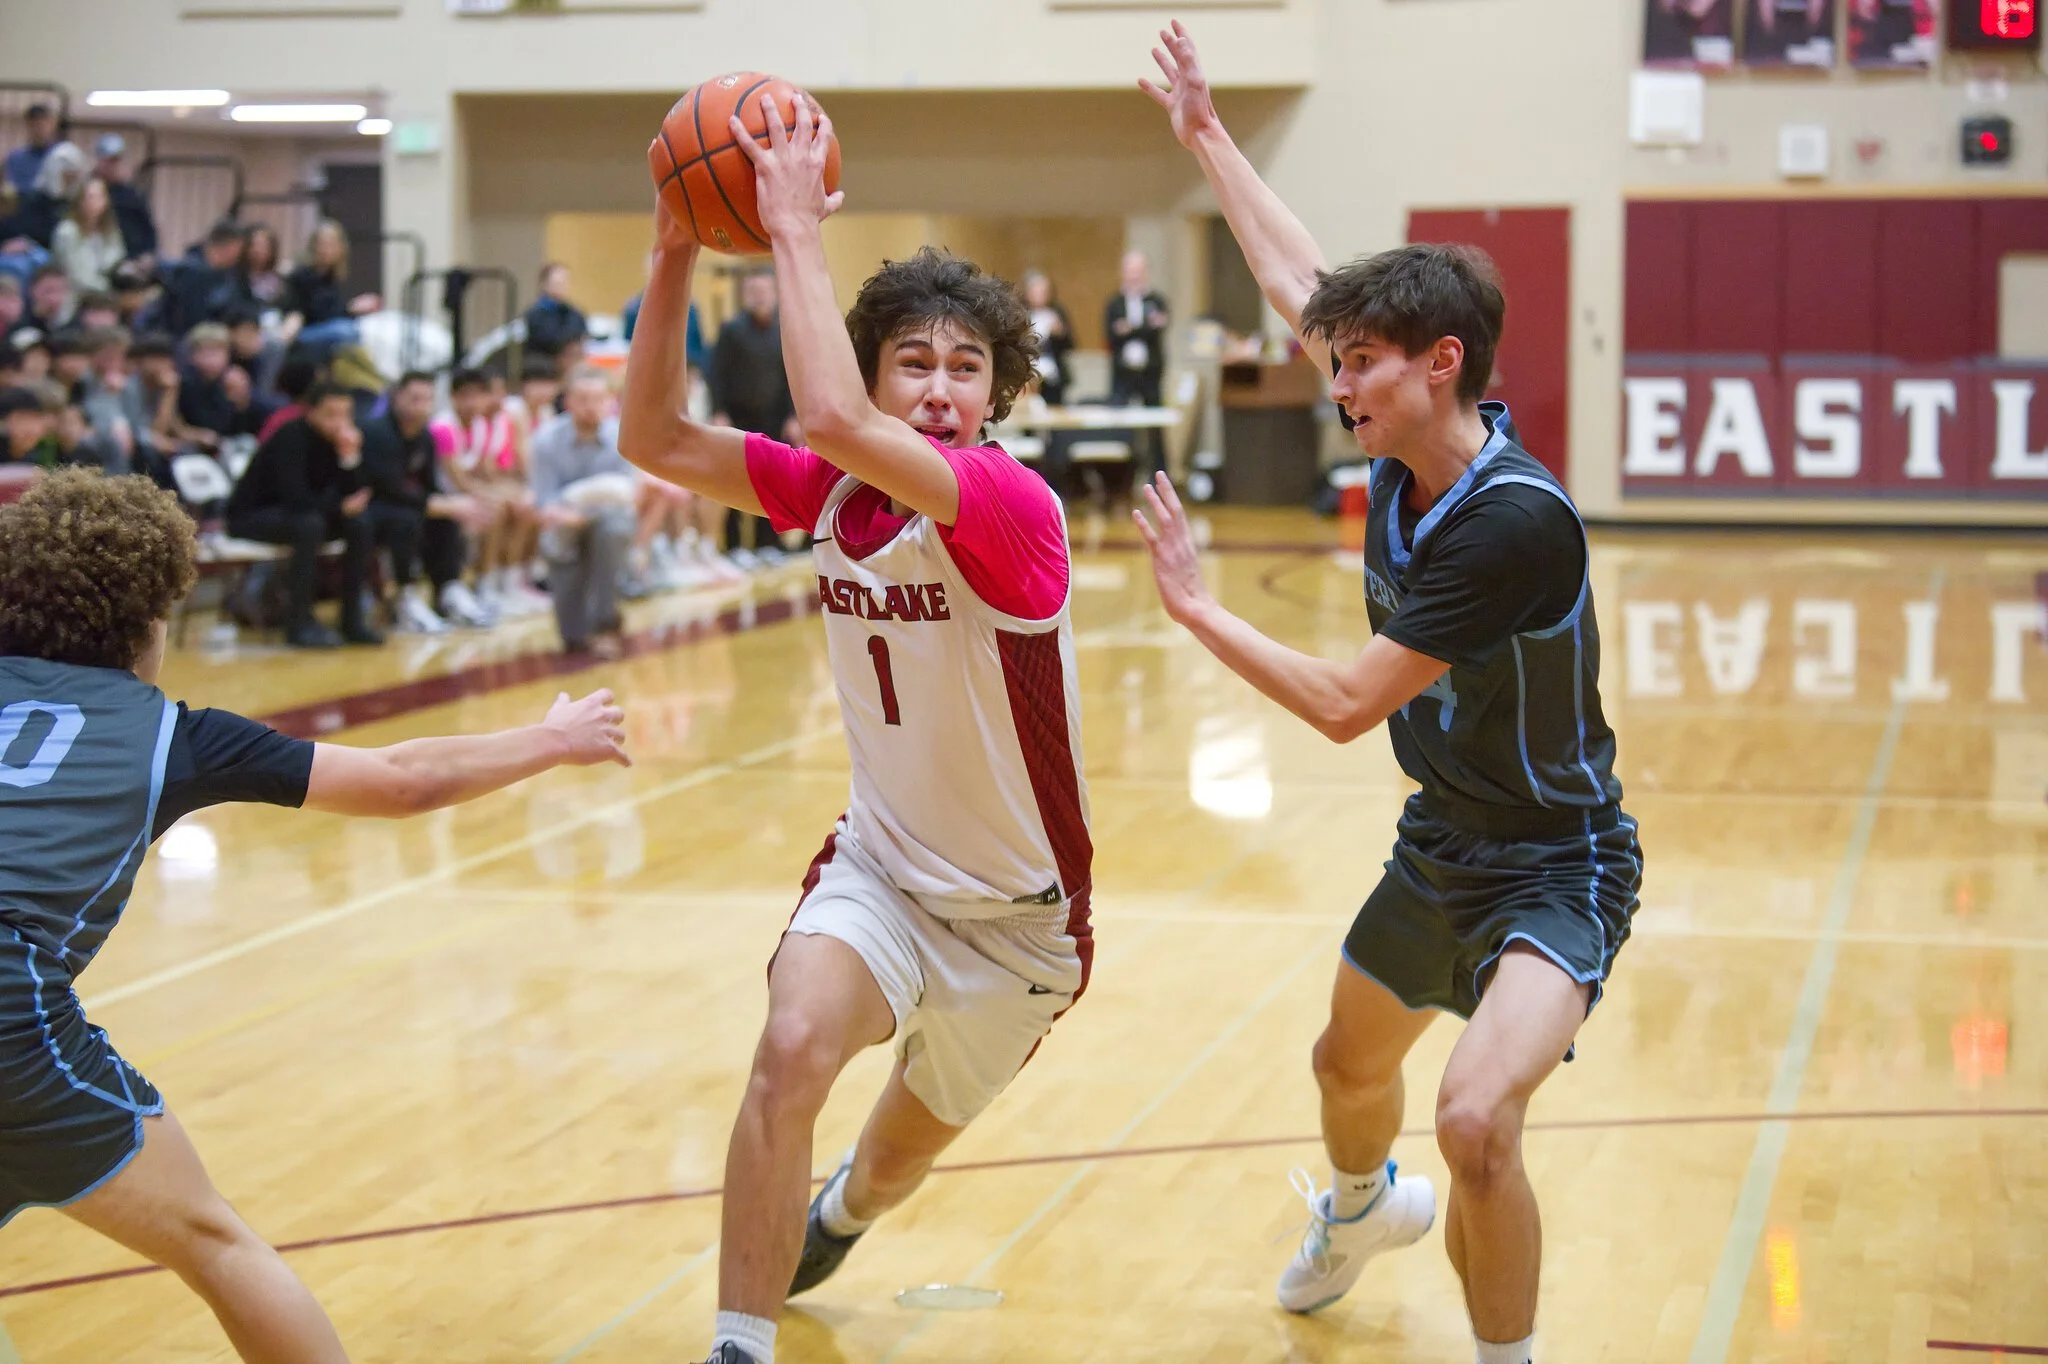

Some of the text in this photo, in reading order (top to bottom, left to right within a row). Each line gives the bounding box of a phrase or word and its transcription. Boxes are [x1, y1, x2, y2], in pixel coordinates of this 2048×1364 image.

[867, 634, 901, 726] 1
[0, 700, 86, 788] 0
[1047, 891, 1055, 902] M
